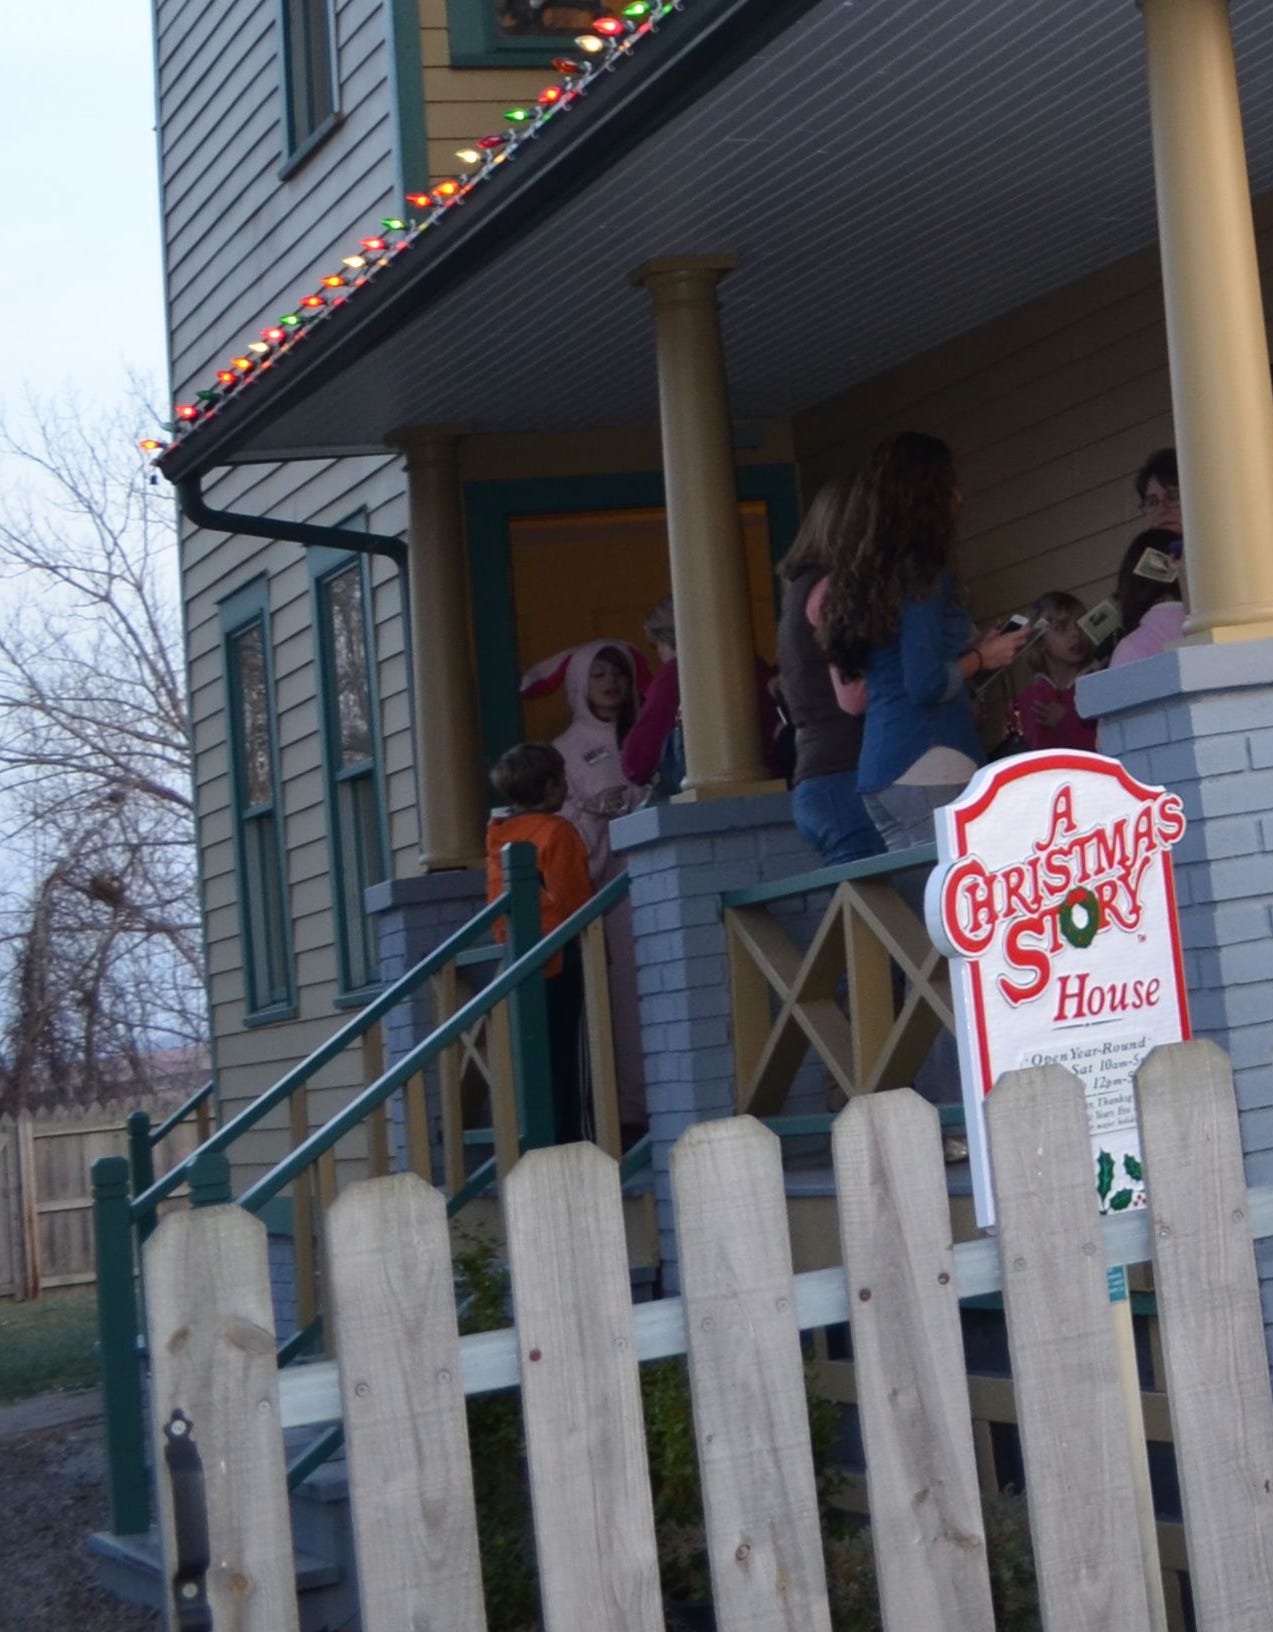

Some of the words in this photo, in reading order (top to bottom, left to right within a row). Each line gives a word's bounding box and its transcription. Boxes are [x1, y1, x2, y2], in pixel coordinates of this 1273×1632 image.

[1035, 785, 1077, 852] A
[944, 795, 1184, 954] CHRISTMAS
[999, 855, 1151, 1004] STORY
[1053, 972, 1160, 1021] House
[1071, 1063, 1093, 1075] Sat
